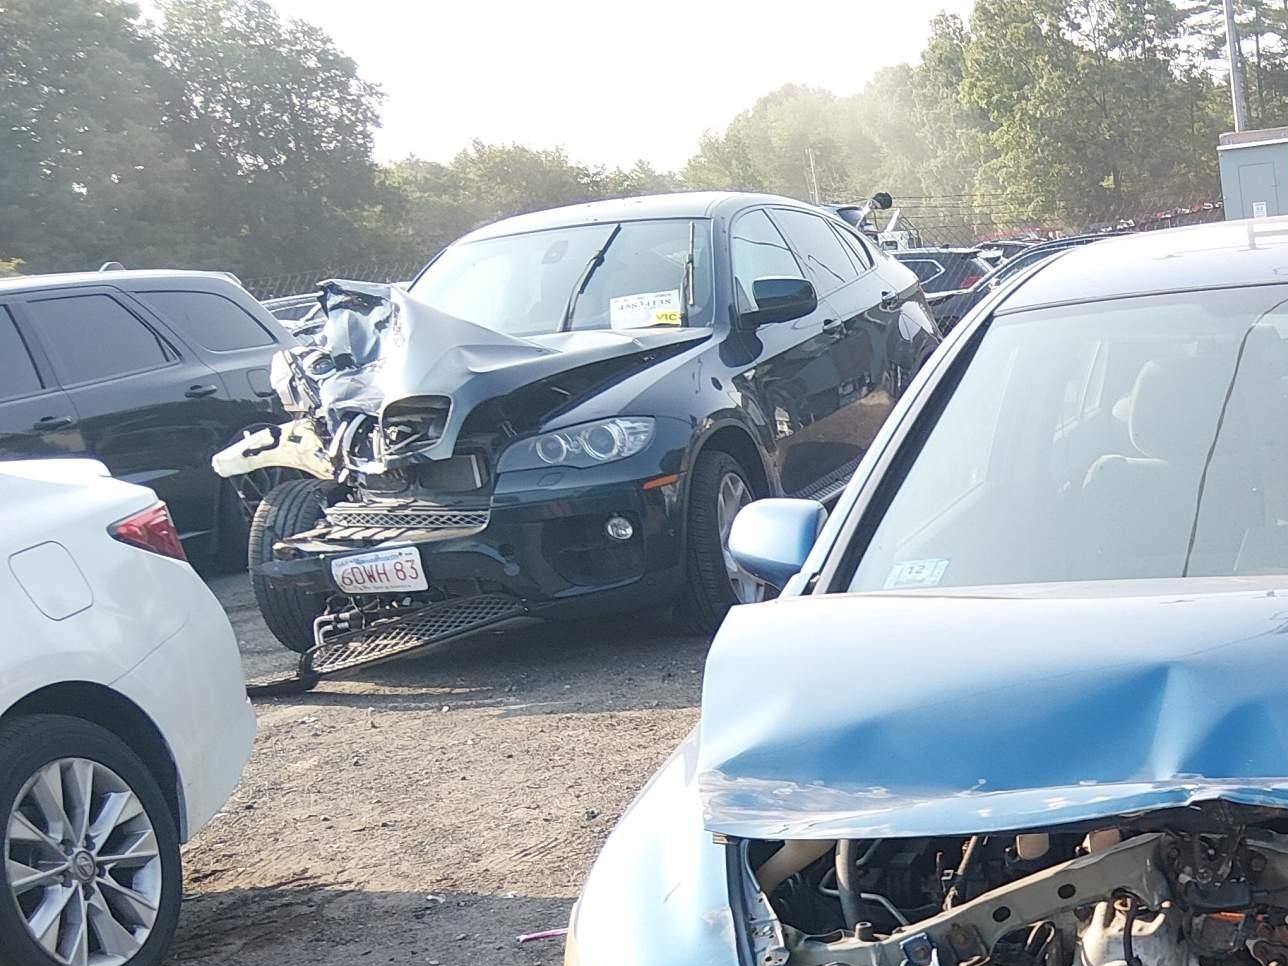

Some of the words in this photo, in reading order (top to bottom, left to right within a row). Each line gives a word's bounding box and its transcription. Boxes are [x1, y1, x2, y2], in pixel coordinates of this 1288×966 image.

[656, 313, 677, 321] VIC
[341, 563, 390, 586] 6DWH
[394, 560, 419, 582] 83
